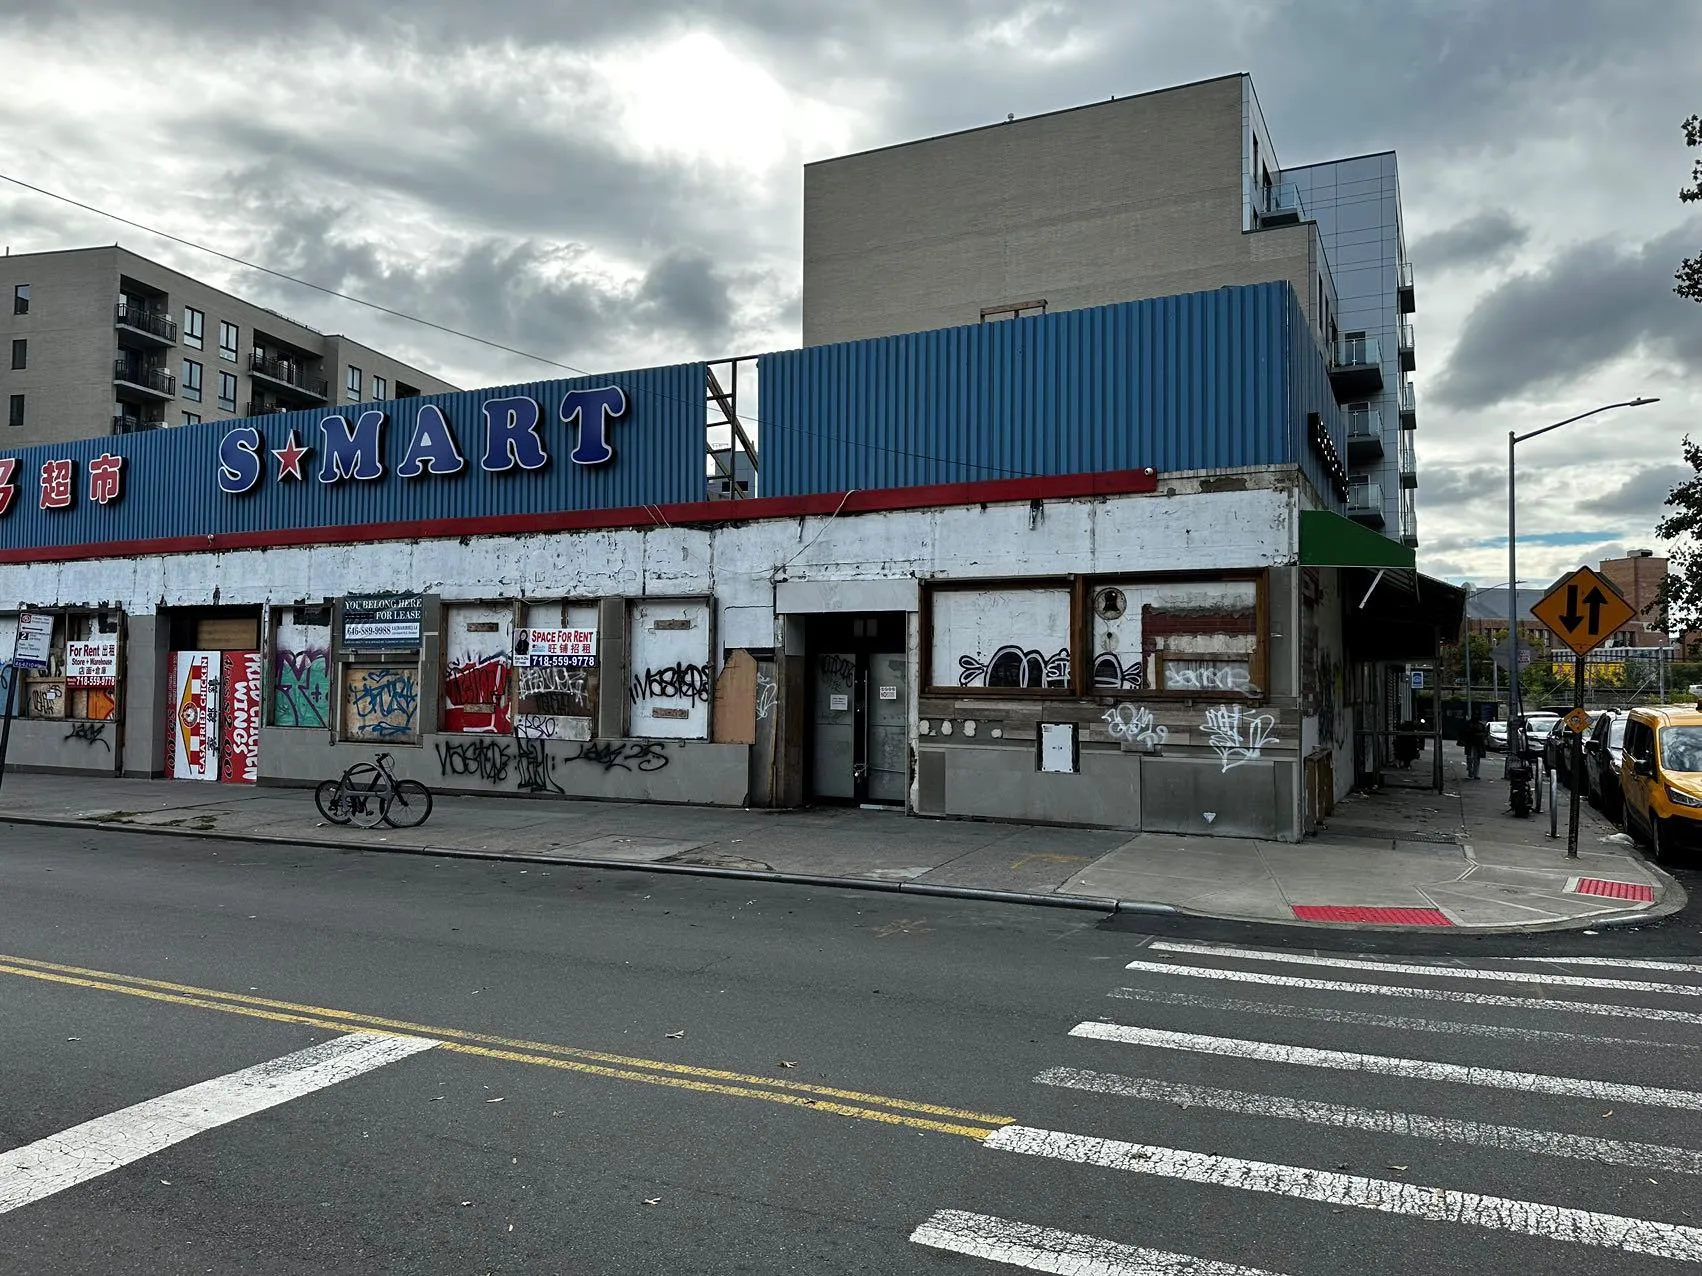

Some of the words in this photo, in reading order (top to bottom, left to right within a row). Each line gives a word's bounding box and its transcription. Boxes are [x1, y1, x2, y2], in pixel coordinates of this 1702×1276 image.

[345, 600, 362, 610] YOU
[362, 599, 397, 609] BELONG
[398, 598, 422, 608] HERE
[376, 611, 392, 620] FOR
[394, 610, 421, 619] LEASE
[531, 630, 556, 643] SPACE
[557, 630, 572, 642] FOR
[573, 630, 594, 642] RENT
[69, 645, 82, 657] For
[83, 645, 100, 657] Rent
[90, 658, 113, 666] Warehouse
[532, 656, 595, 666] 718-559-9778
[76, 677, 115, 686] 718-559-9778
[200, 659, 208, 707] CHICKEN
[233, 681, 248, 755] WINGS
[199, 711, 207, 740] FRIED
[198, 745, 206, 773] CASA
